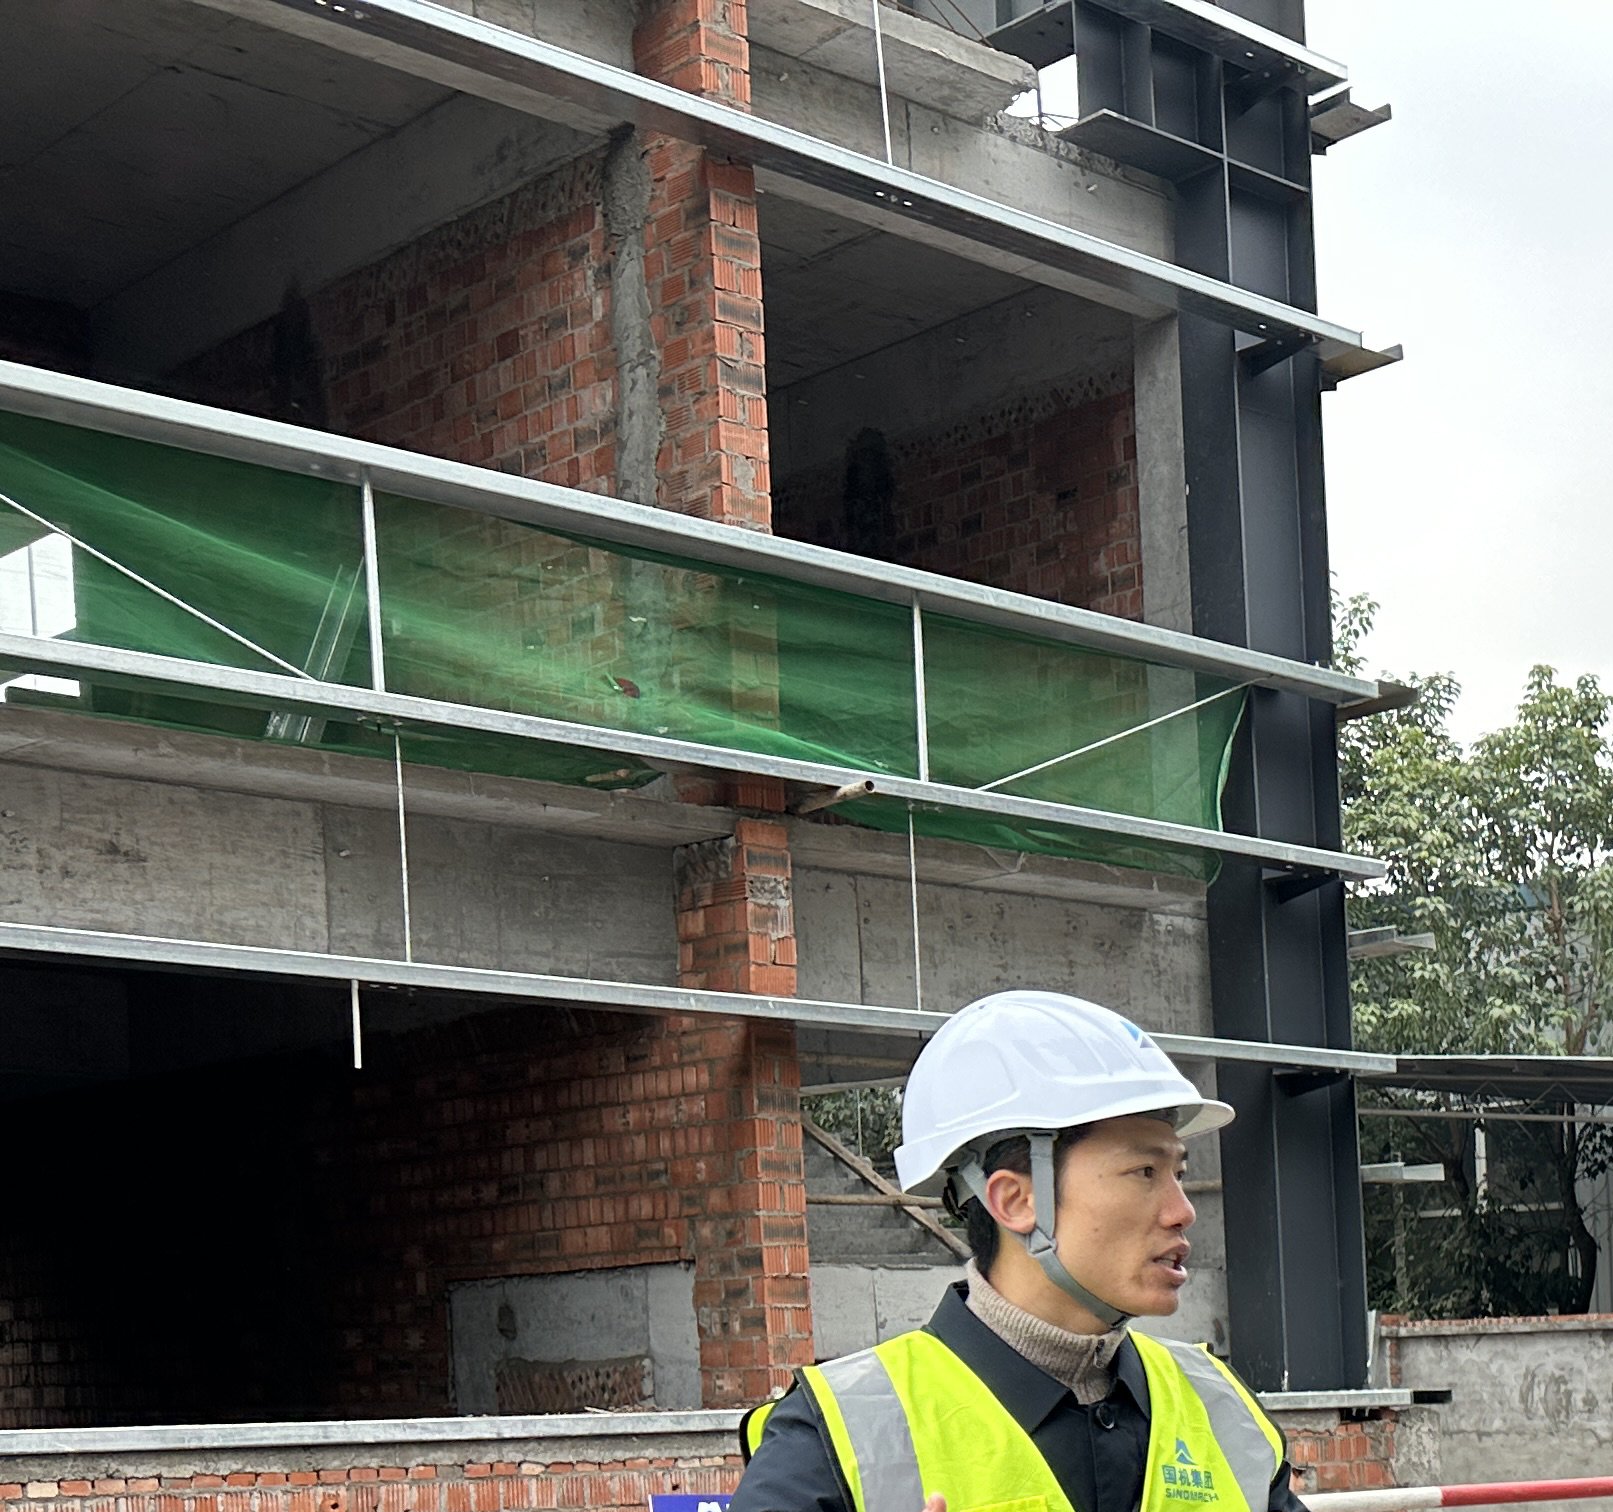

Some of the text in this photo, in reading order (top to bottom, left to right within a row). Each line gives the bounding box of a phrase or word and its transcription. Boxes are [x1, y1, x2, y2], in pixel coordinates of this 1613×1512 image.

[1162, 1465, 1214, 1490] 国机集团
[1166, 1488, 1219, 1503] SINOMACH
